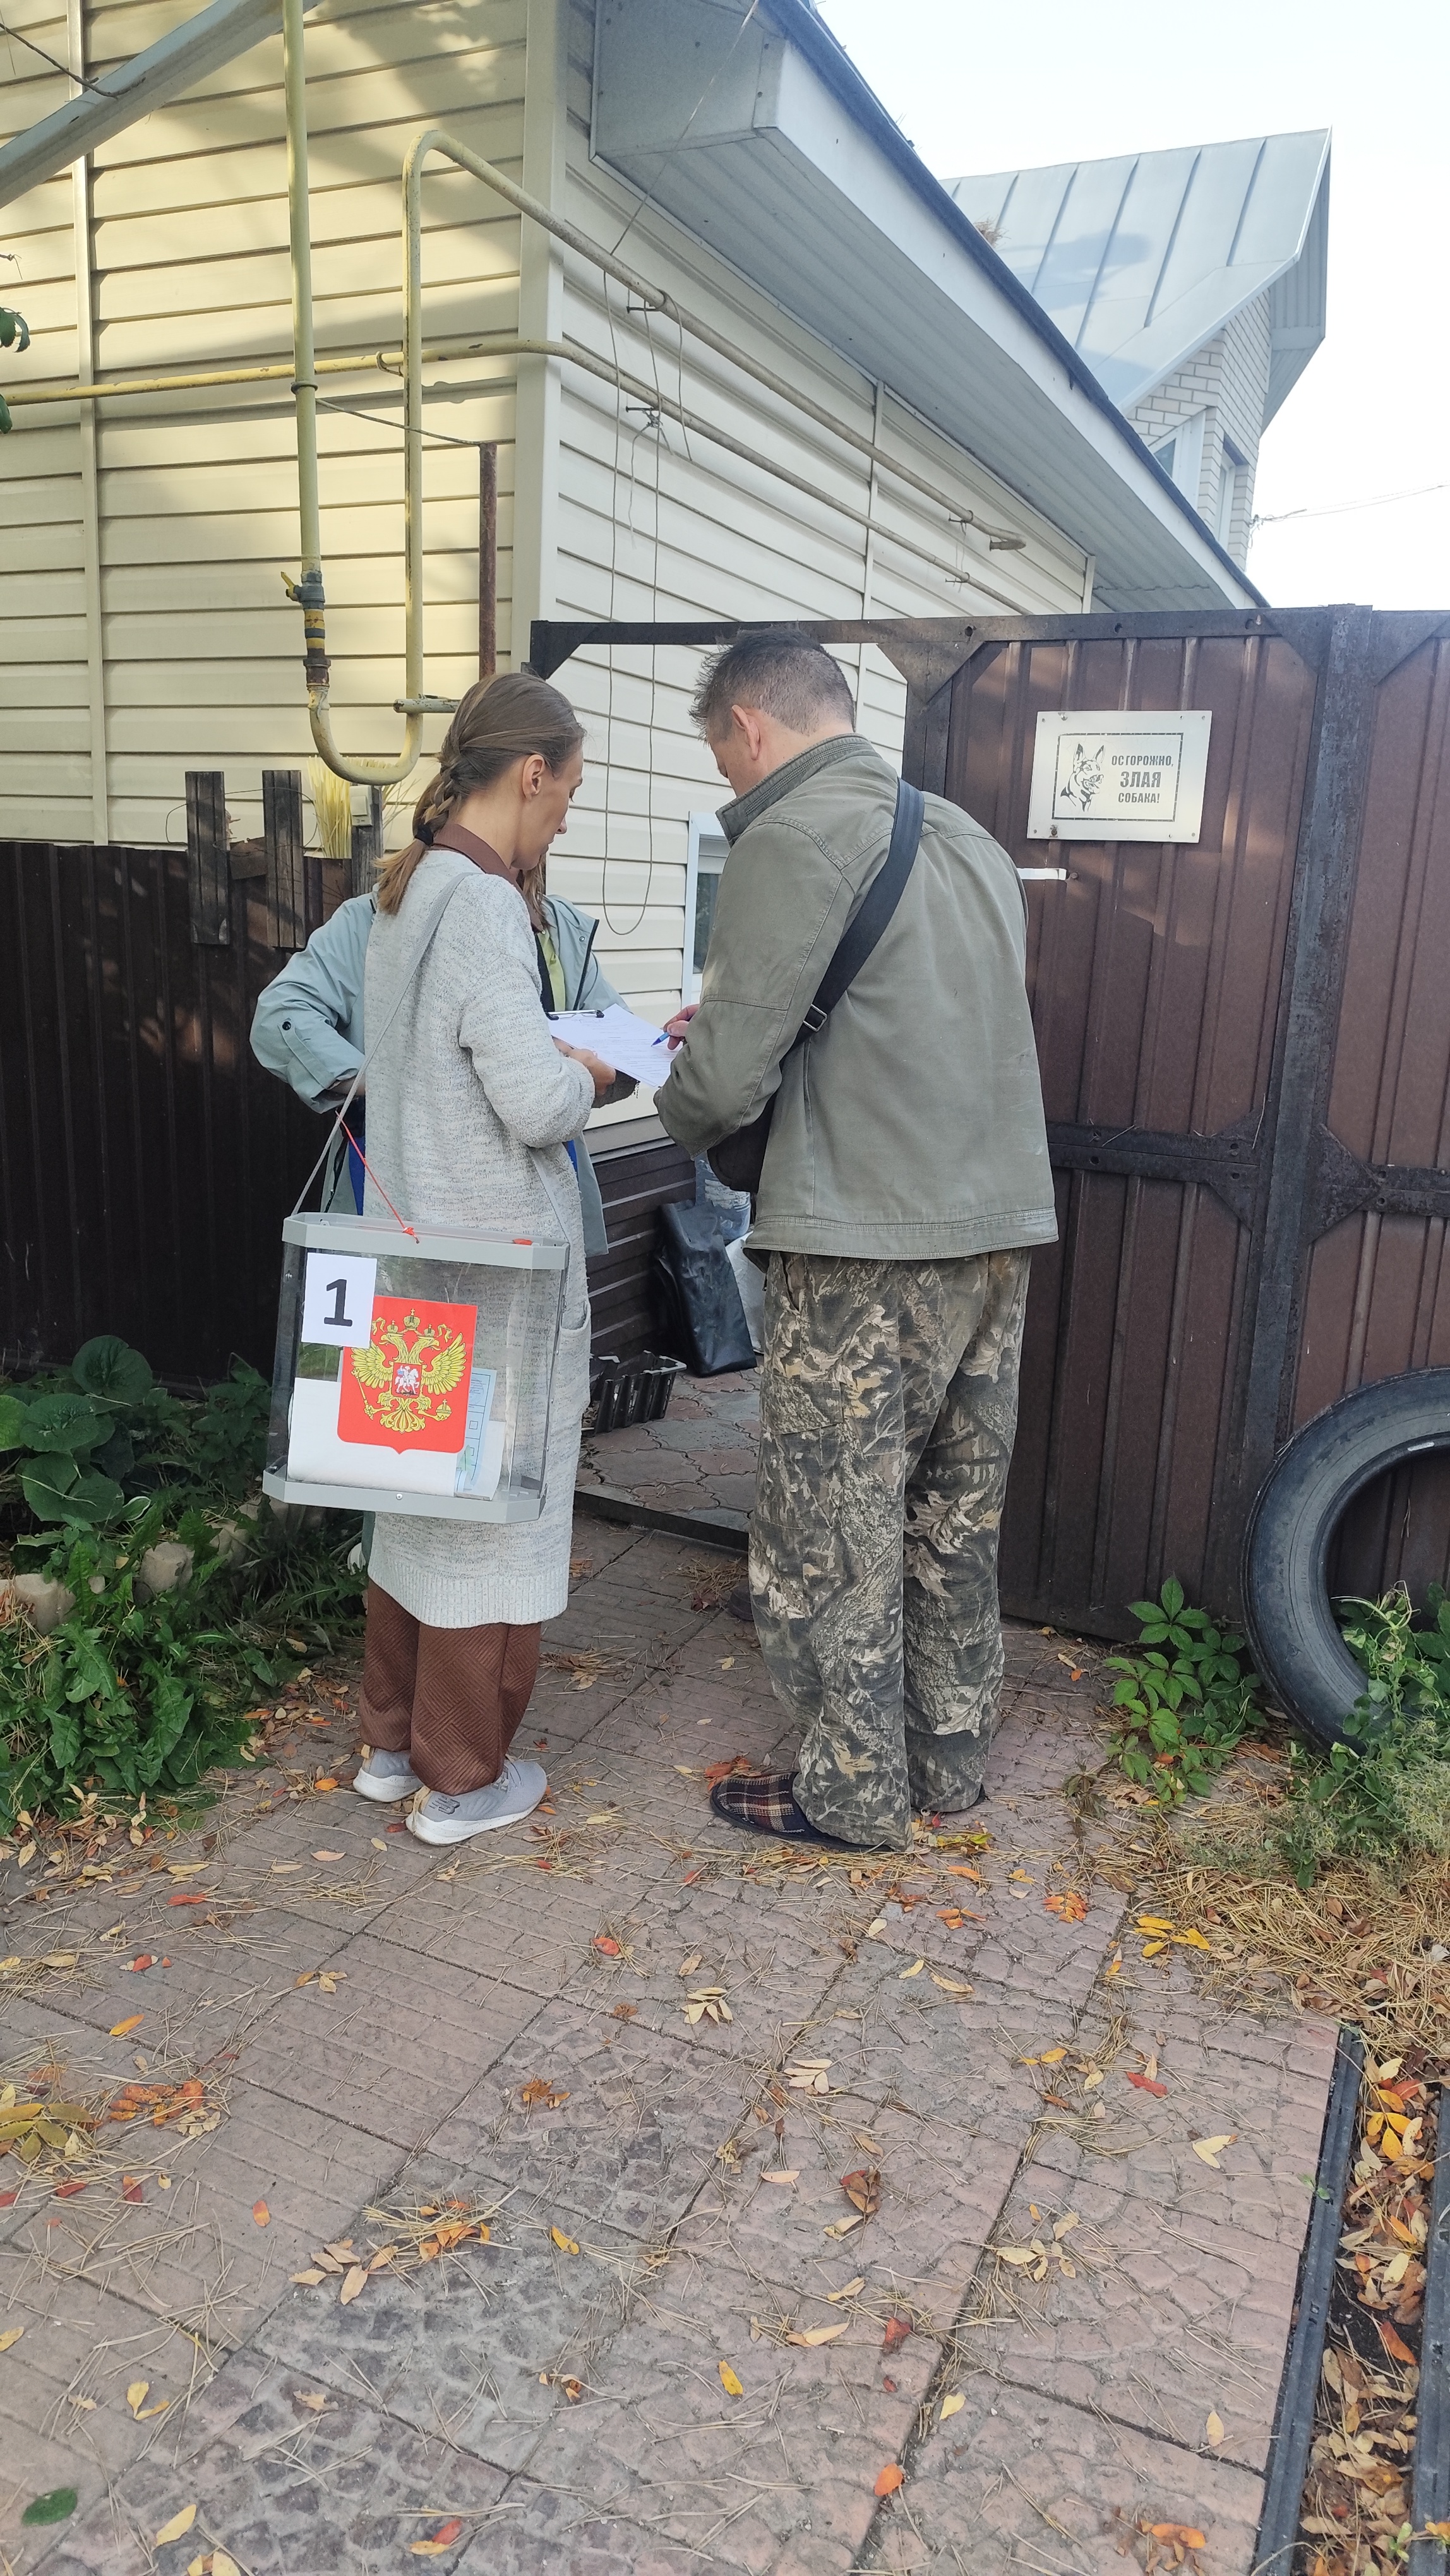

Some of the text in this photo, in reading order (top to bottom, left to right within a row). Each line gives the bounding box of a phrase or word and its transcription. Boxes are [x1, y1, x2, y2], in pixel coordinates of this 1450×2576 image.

[1120, 772, 1161, 788] ЗЛАЯ
[1118, 793, 1160, 804] СОБАКА!
[324, 1279, 352, 1327] 1
